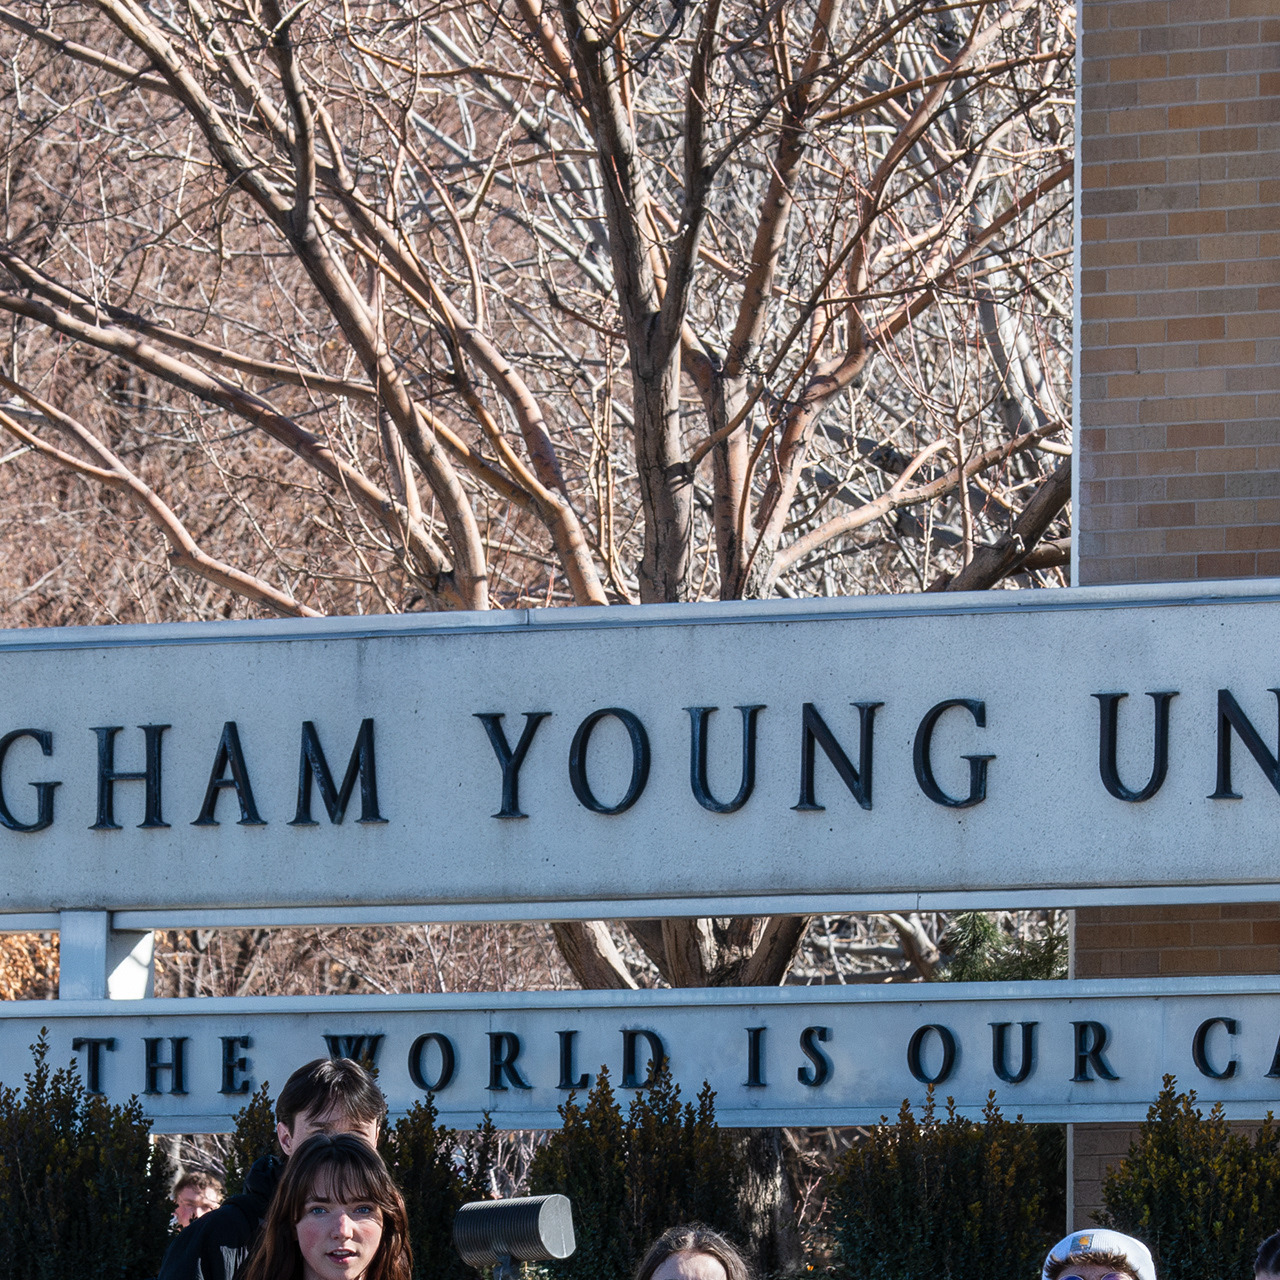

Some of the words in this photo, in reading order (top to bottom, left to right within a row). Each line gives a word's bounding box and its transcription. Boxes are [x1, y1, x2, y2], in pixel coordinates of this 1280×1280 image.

[472, 697, 997, 820] YOUNG
[71, 1034, 253, 1096] THE
[743, 1025, 832, 1087] IS
[907, 1020, 1120, 1085] OUR
